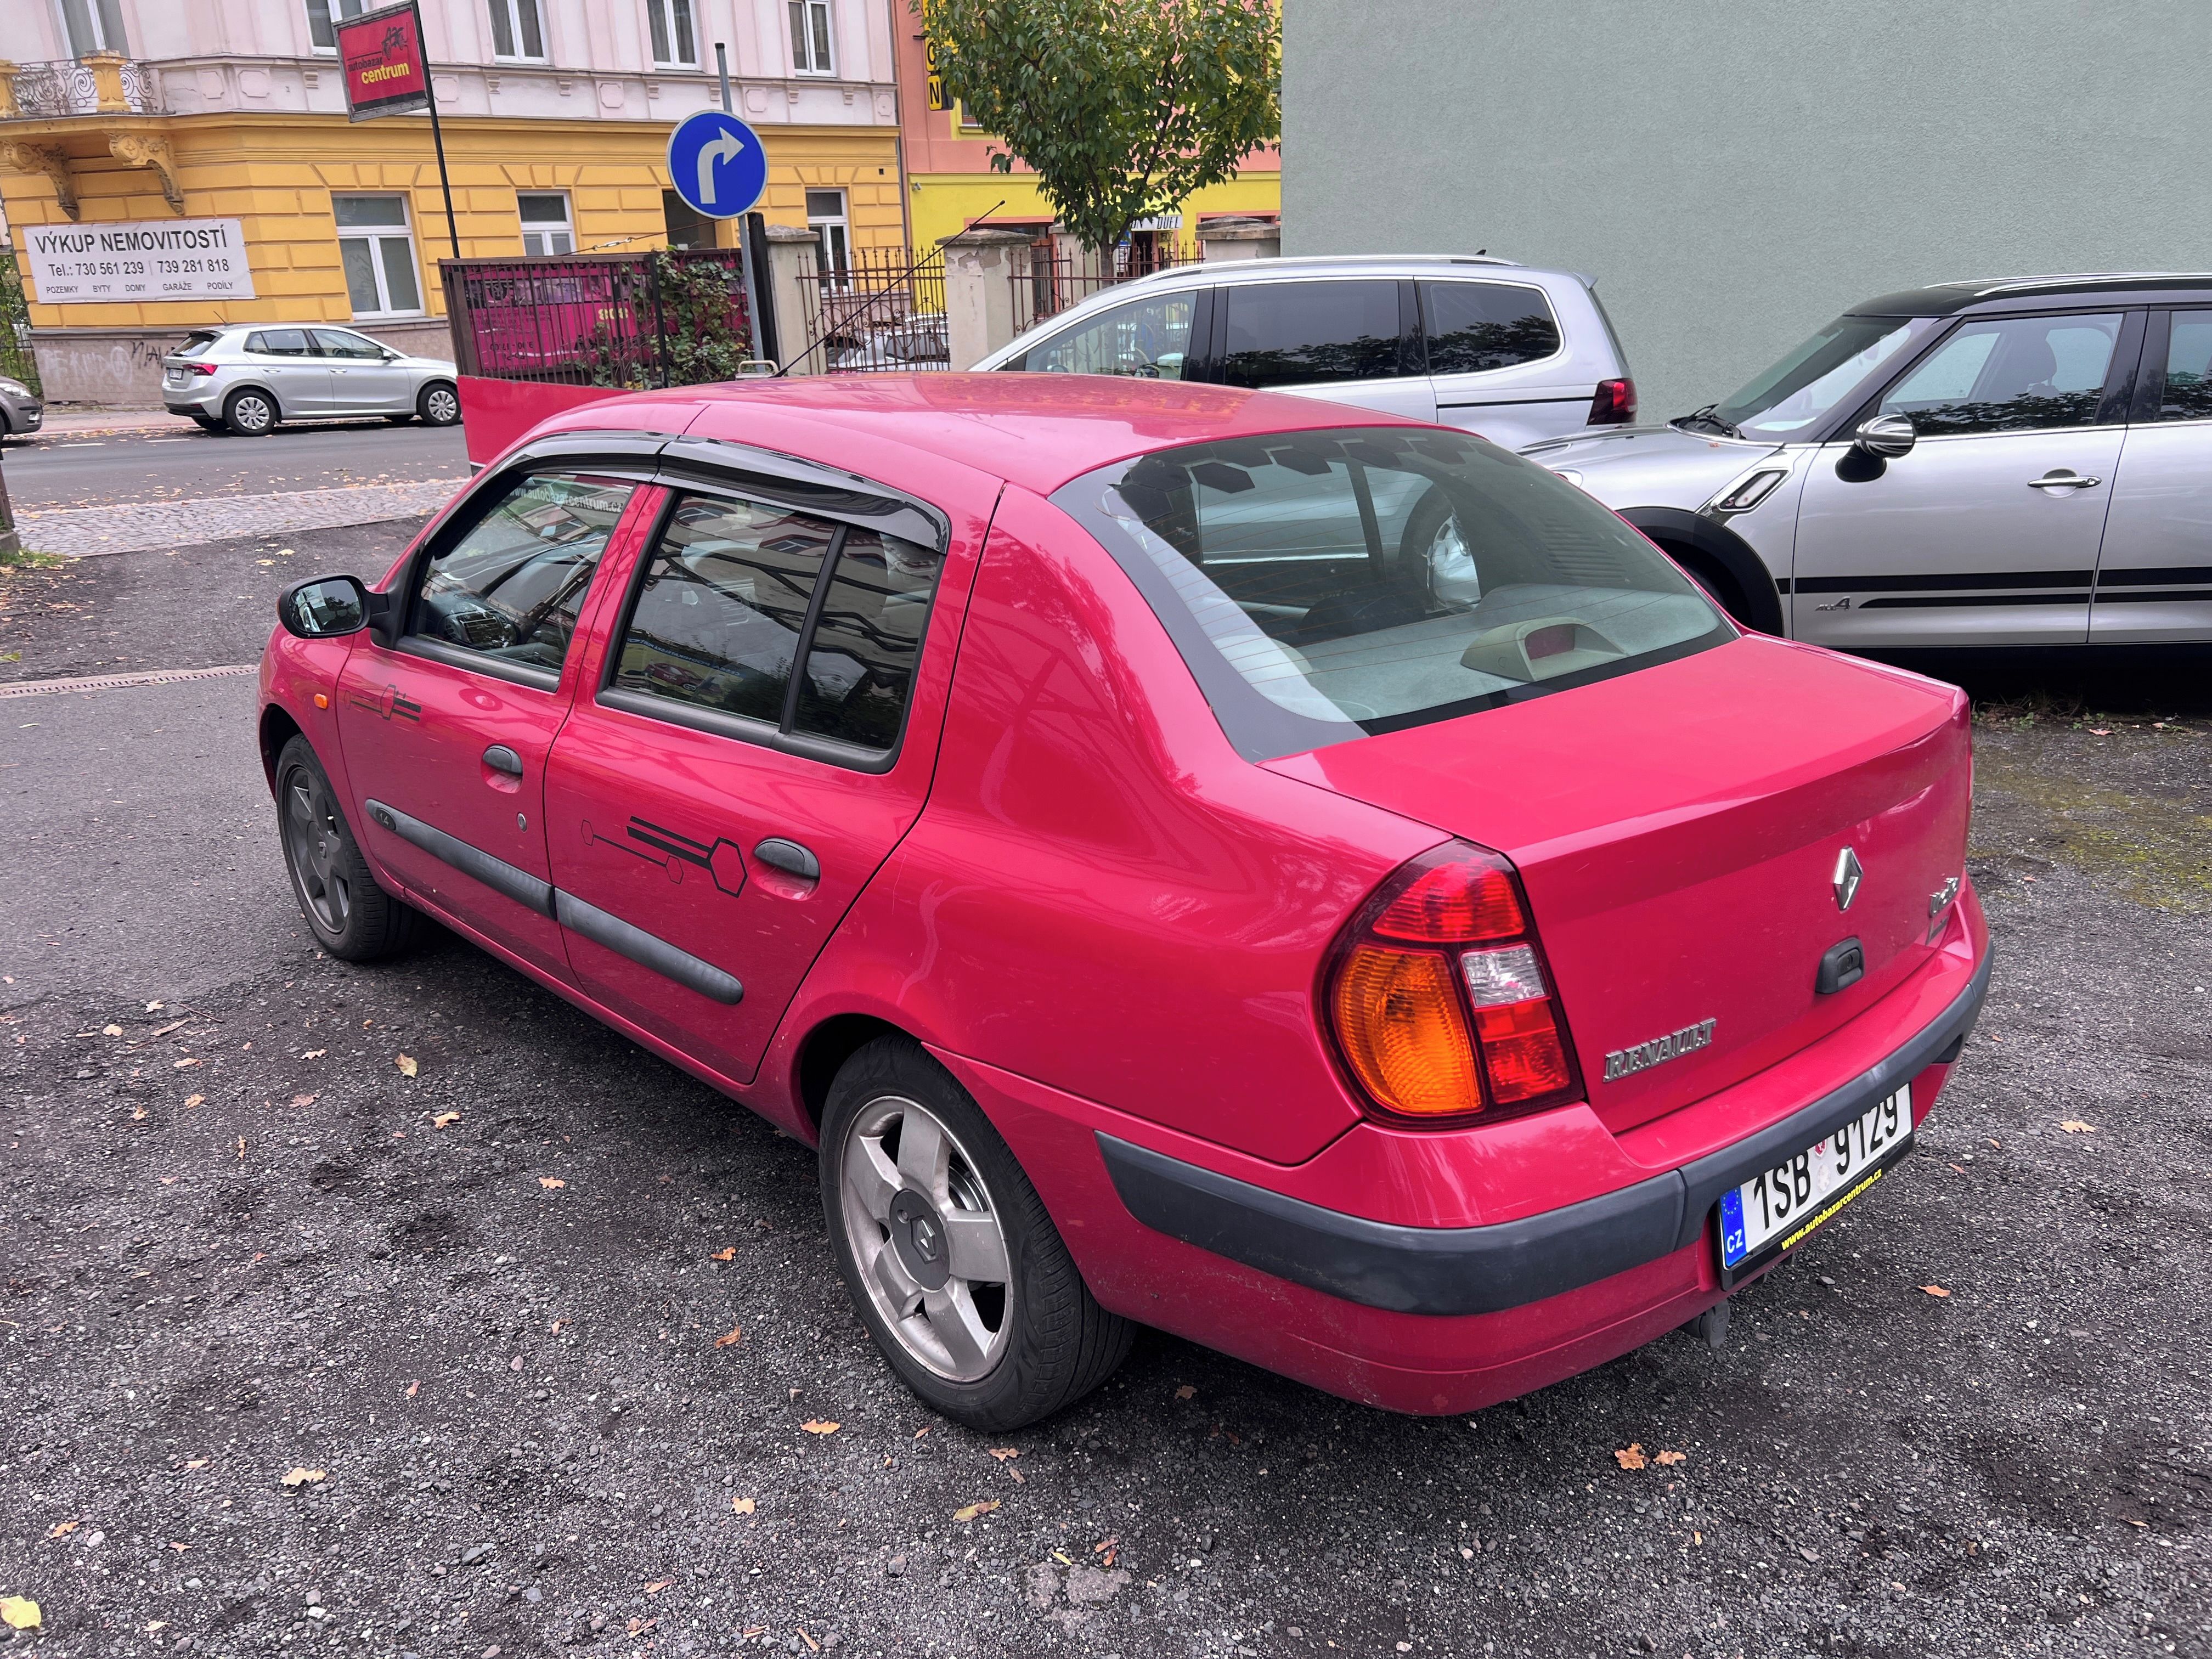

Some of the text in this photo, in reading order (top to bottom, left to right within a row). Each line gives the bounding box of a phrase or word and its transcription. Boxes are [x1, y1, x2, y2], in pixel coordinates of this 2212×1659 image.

[361, 62, 410, 84] centrum
[35, 224, 227, 254] VÝKUP NEMOVITOSTÍ
[48, 258, 229, 276] Tel.: 730 561 239 739 281 818
[46, 280, 233, 294] POZEMKY BYTY DOMY GARÁŽE PODÍLY
[1602, 1017, 1717, 1083] RENAULT
[1781, 1168, 1882, 1251] www.autobazarcentrum.cz
[1726, 1229, 1743, 1254] CZ
